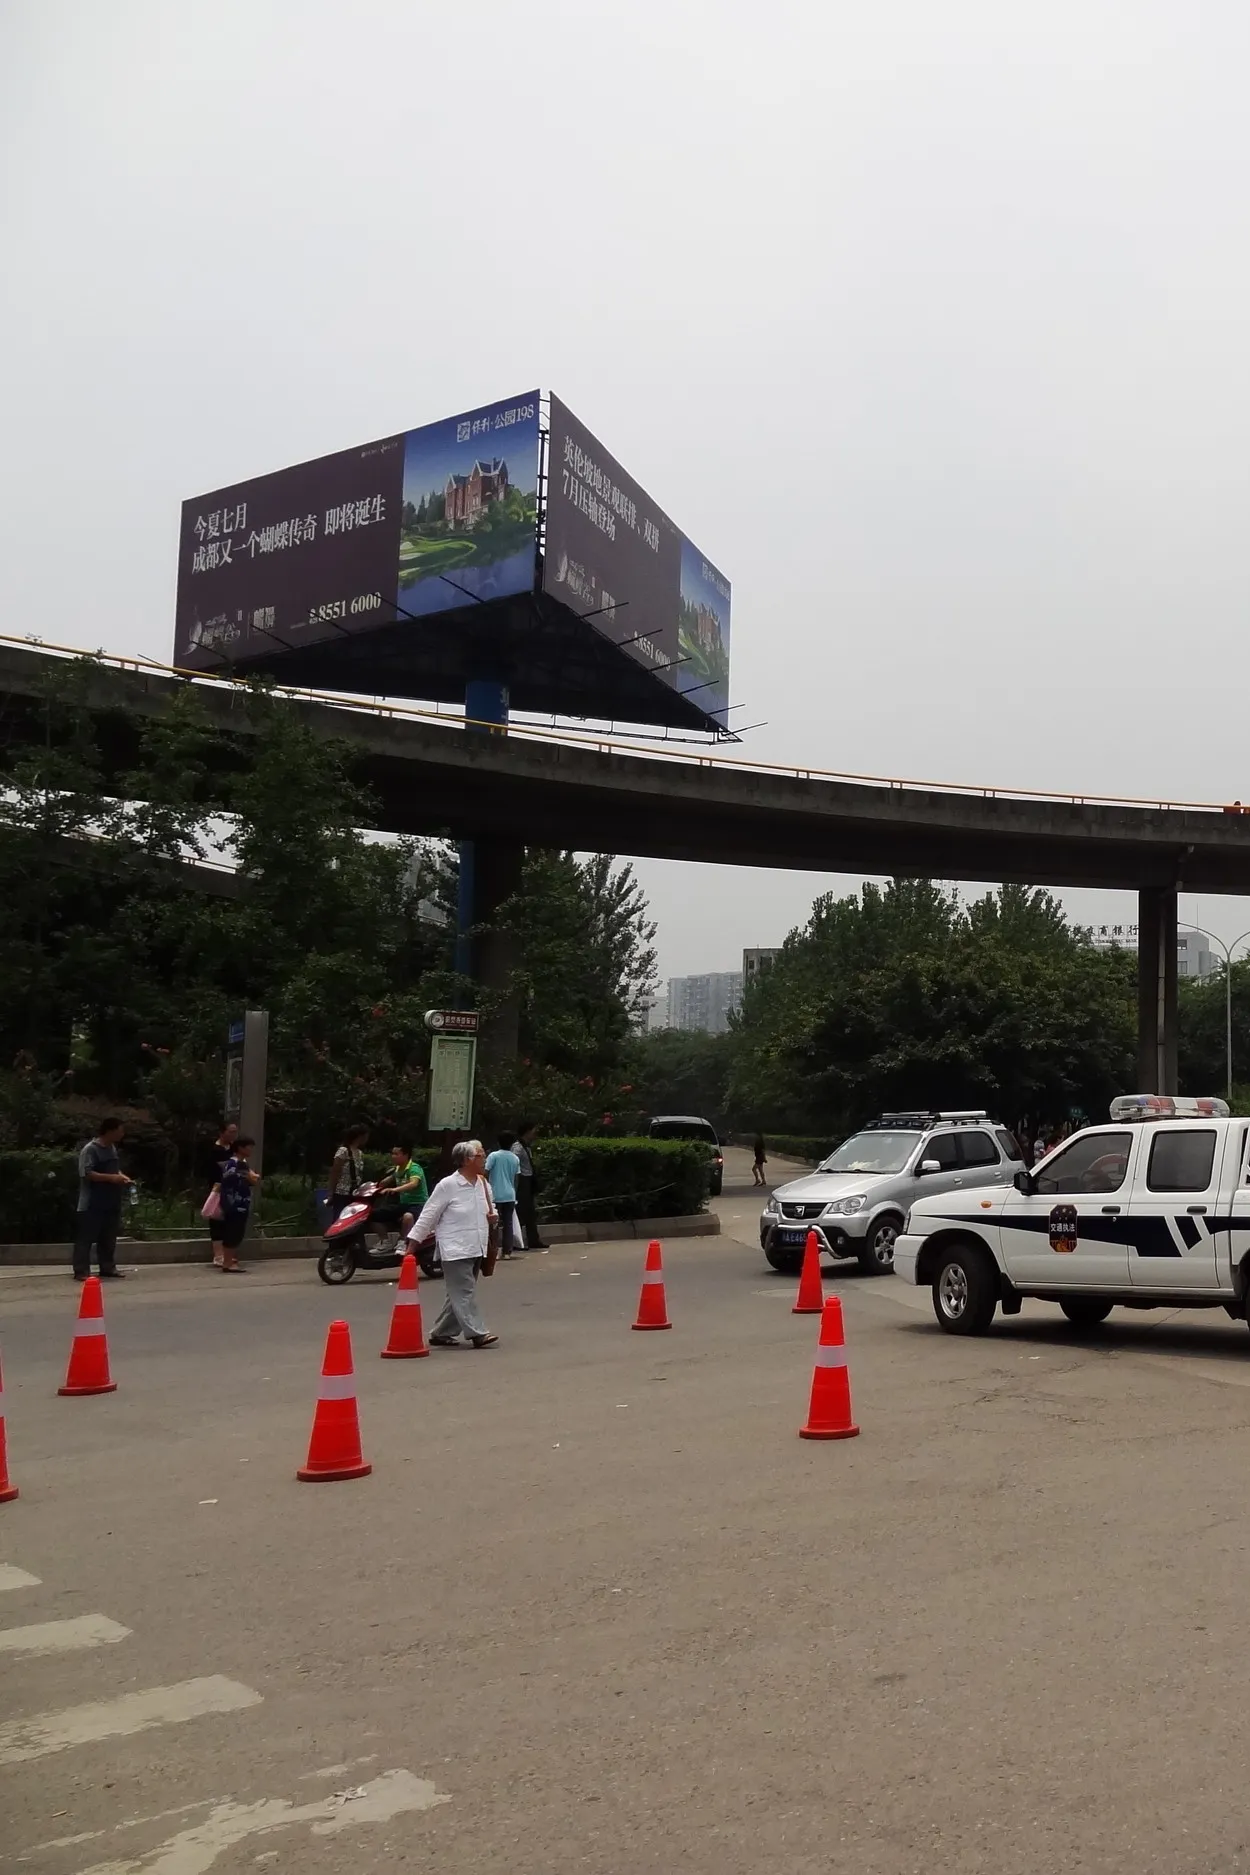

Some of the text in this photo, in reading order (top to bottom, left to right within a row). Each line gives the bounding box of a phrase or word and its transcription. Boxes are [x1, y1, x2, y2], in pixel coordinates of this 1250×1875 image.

[193, 503, 248, 542] 今夏七月
[562, 468, 616, 541] 7月压轴登场
[191, 494, 387, 575] 成都又一个蝴蝶传奇 即将诞生
[318, 592, 382, 623] 8551 6000
[1050, 1222, 1076, 1232] 交通执法
